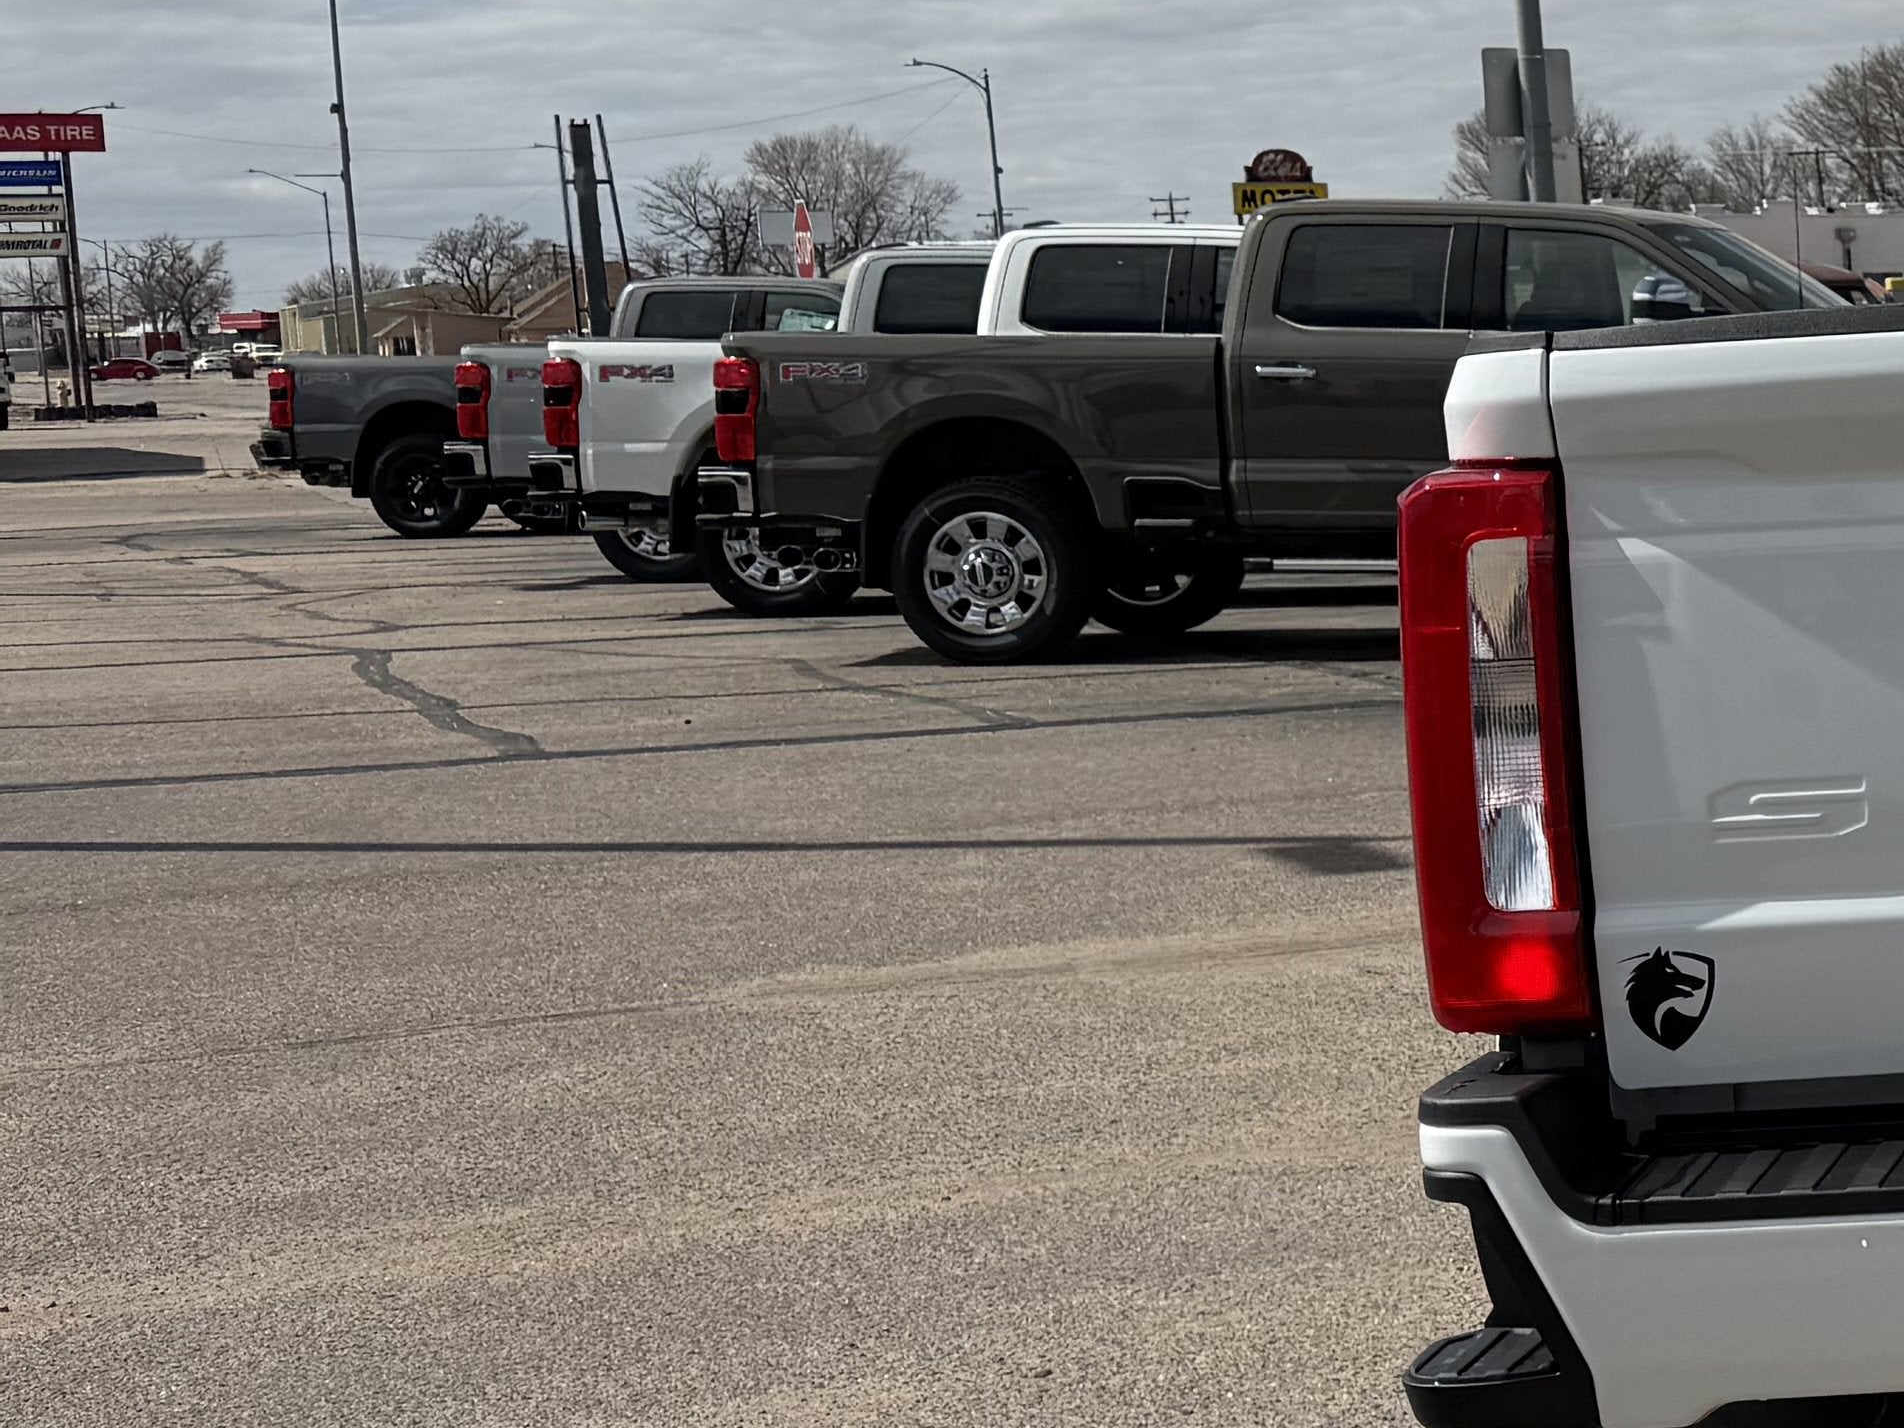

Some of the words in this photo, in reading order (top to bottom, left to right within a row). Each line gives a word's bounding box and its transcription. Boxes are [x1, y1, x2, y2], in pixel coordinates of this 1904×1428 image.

[46, 125, 96, 141] TIRE
[795, 230, 814, 266] STOP
[598, 363, 675, 383] FX4
[779, 361, 869, 383] FX4
